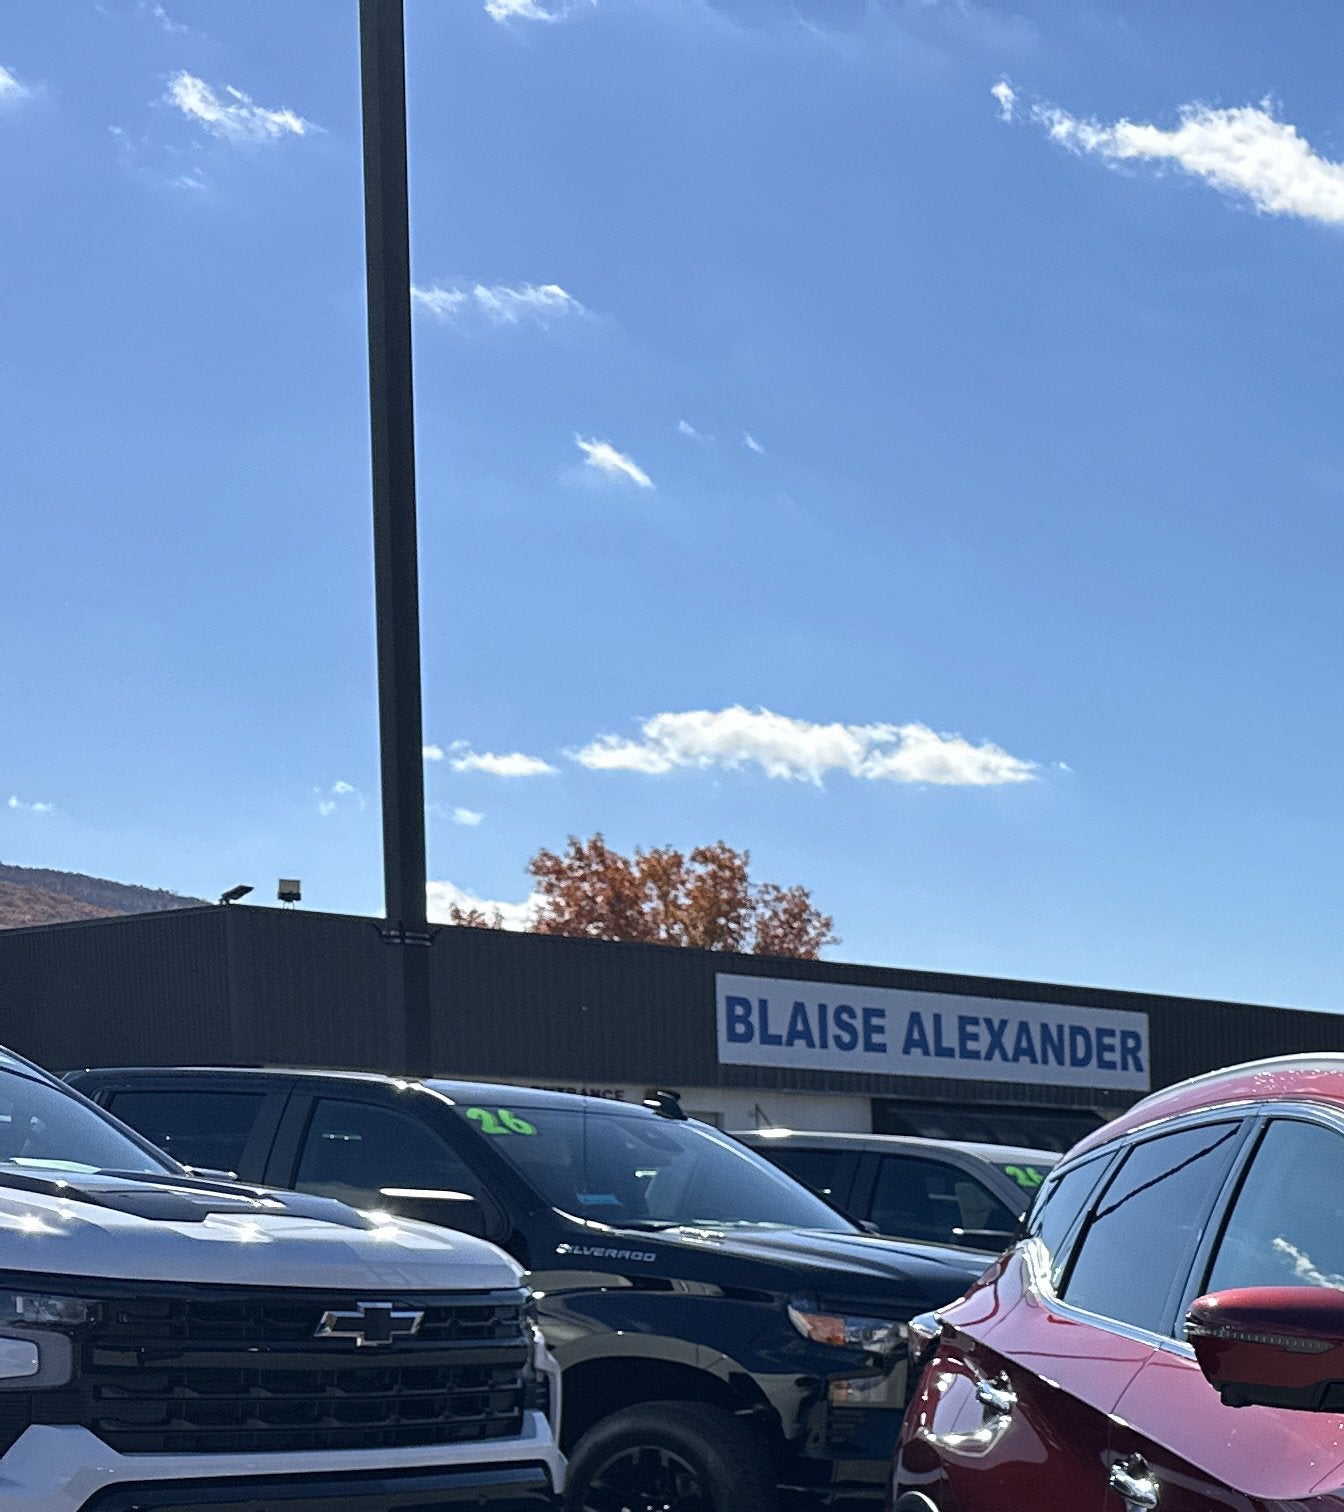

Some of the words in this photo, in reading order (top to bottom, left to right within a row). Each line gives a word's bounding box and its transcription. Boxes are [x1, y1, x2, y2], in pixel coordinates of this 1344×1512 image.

[724, 995, 888, 1053] BLAISE
[902, 1011, 1145, 1073] ALEXANDER
[465, 1107, 537, 1136] 26
